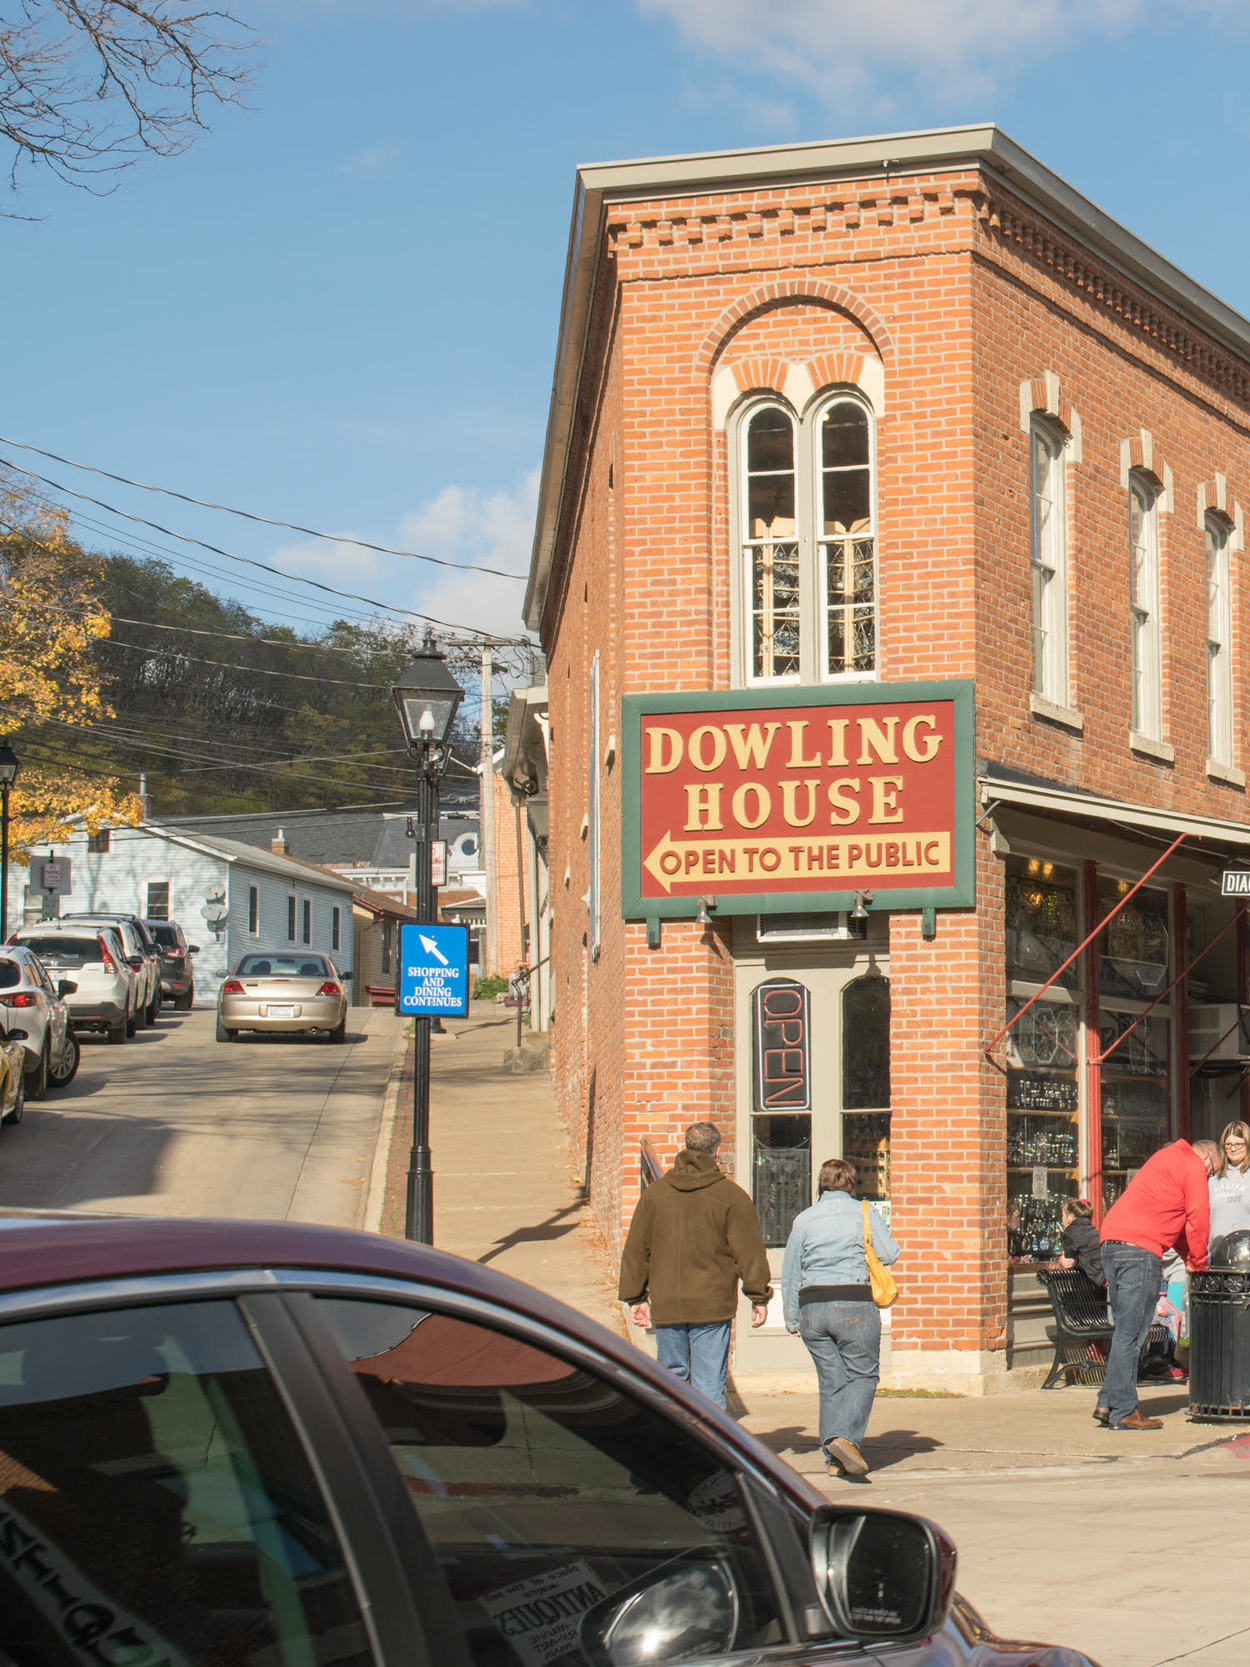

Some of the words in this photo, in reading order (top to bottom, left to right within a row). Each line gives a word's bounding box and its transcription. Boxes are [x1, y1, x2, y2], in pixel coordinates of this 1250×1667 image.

[645, 715, 943, 774] DOWLING
[683, 776, 904, 832] HOUSE
[659, 848, 736, 875] OPEN
[743, 846, 782, 872] TO
[789, 844, 840, 871] THE
[848, 840, 939, 868] PUBLIC
[407, 966, 459, 978] SHOPPING
[422, 977, 445, 987] AND
[403, 995, 462, 1007] CONTINUES
[414, 986, 452, 997] DINING
[763, 989, 804, 1105] OPEN
